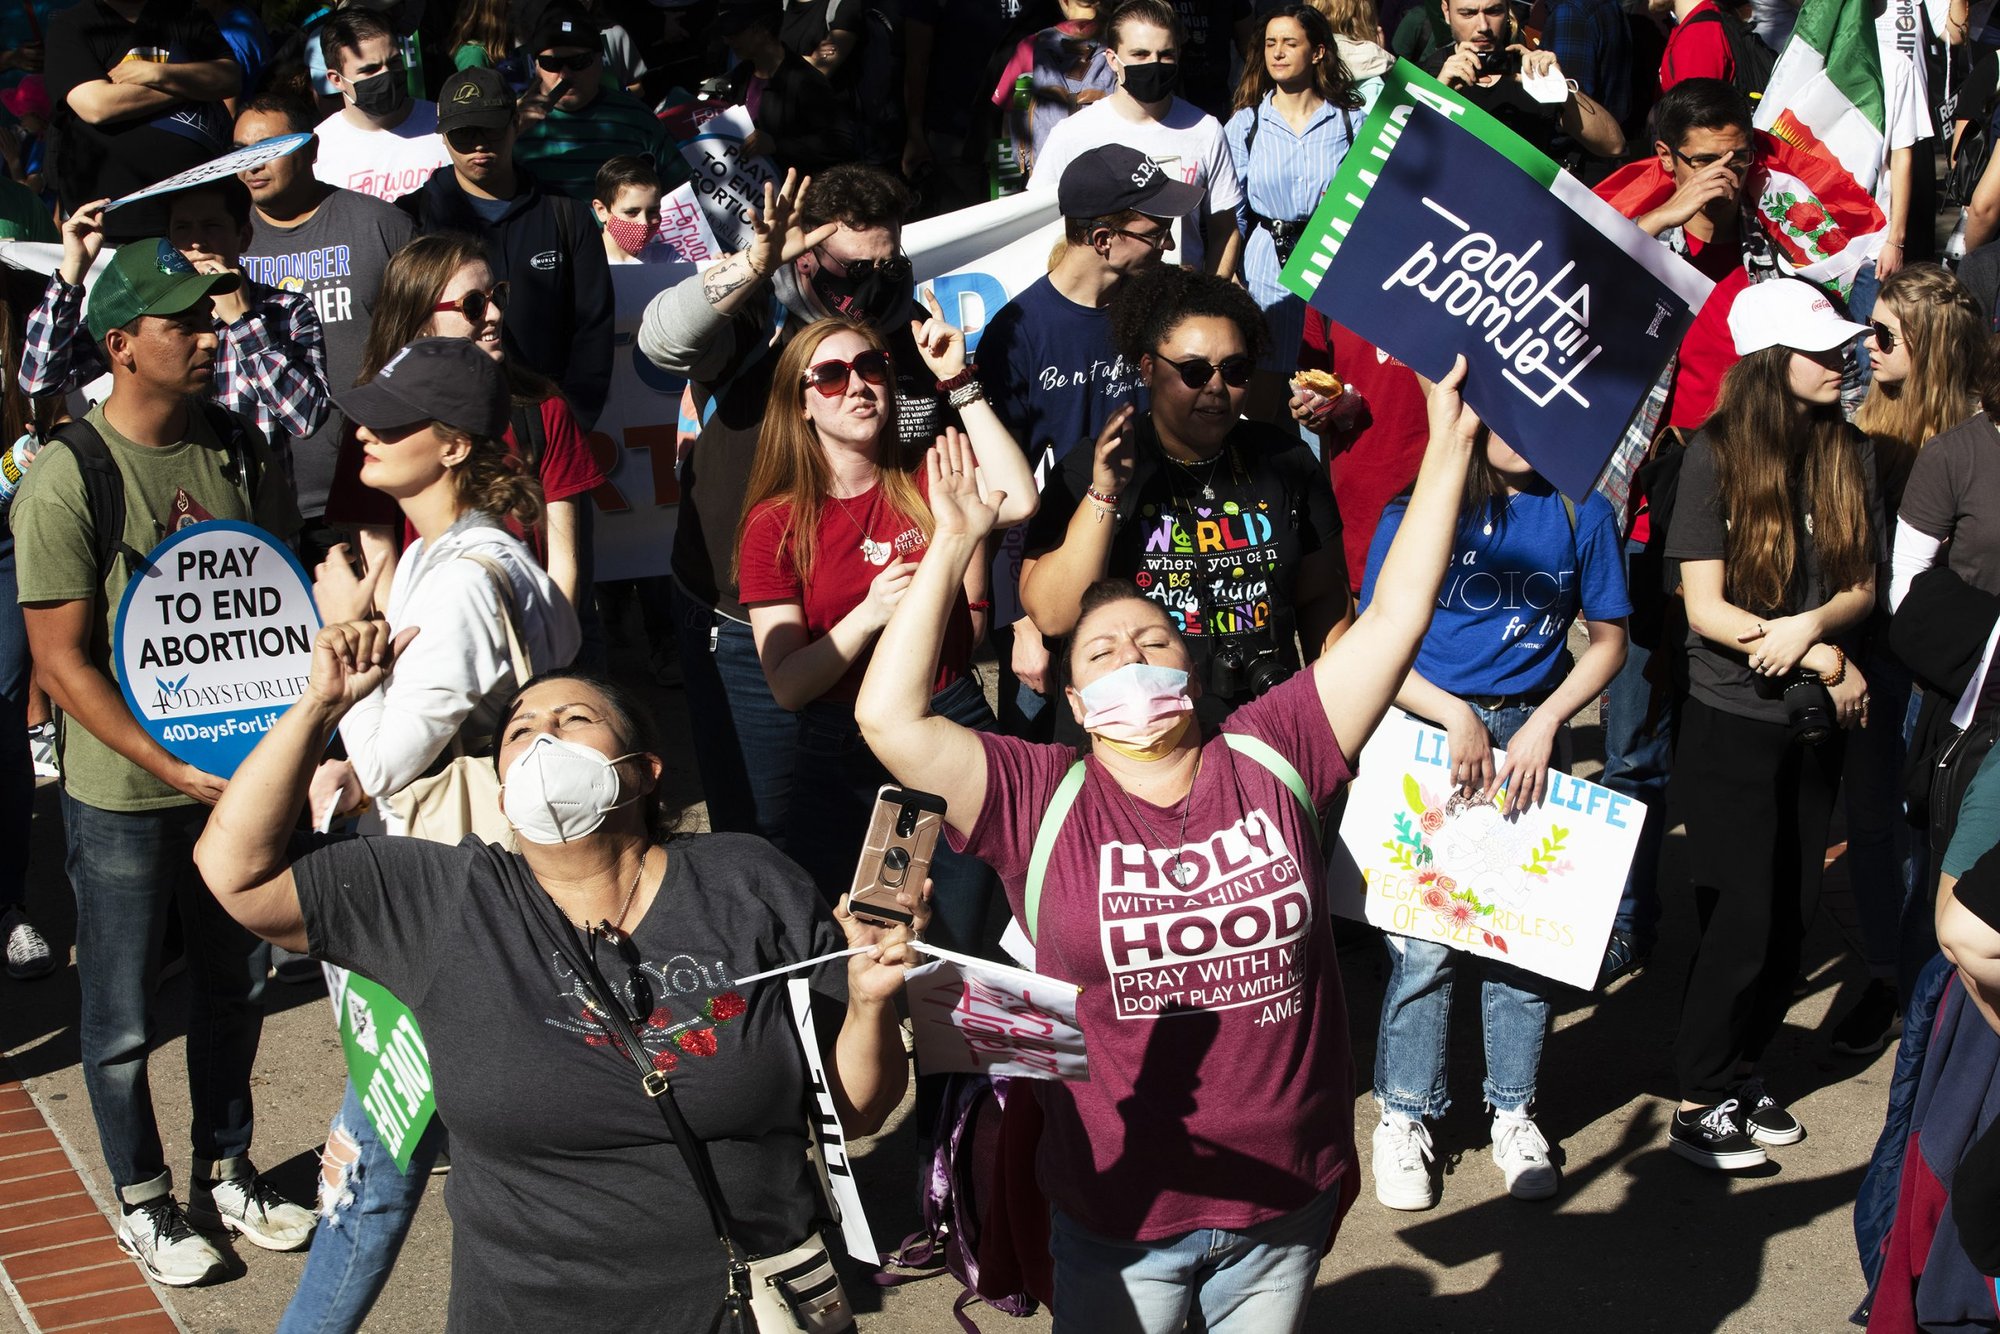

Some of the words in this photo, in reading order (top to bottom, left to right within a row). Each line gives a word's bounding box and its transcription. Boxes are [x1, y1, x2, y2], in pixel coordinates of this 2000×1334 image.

[701, 151, 727, 177] TO
[723, 145, 773, 185] PRAY
[1442, 231, 1590, 335] Hope
[1382, 240, 1602, 409] Forward
[1553, 320, 1590, 364] in
[1039, 366, 1069, 391] Be
[178, 546, 260, 582] PRAY
[1207, 556, 1242, 572] you
[155, 592, 202, 625] TO
[213, 586, 282, 621] END
[139, 624, 312, 670] ABORTION
[184, 683, 232, 708] DAYS
[234, 680, 273, 703] FOR
[1549, 772, 1632, 830] LIFE
[1110, 816, 1275, 893] HOLY
[1108, 896, 1175, 914] WITH
[1183, 897, 1203, 908] A
[1207, 870, 1266, 906] HINT
[1270, 858, 1296, 883] OF
[1109, 891, 1308, 967] HOOD
[1392, 904, 1426, 931] OF
[1118, 966, 1188, 993] PRAY
[1198, 952, 1269, 984] WITH
[1123, 991, 1185, 1013] DON'T
[1189, 984, 1234, 1007] PLAY
[1238, 973, 1284, 998] WITH
[379, 1014, 432, 1119] LOVE
[362, 1067, 411, 1159] LIFE
